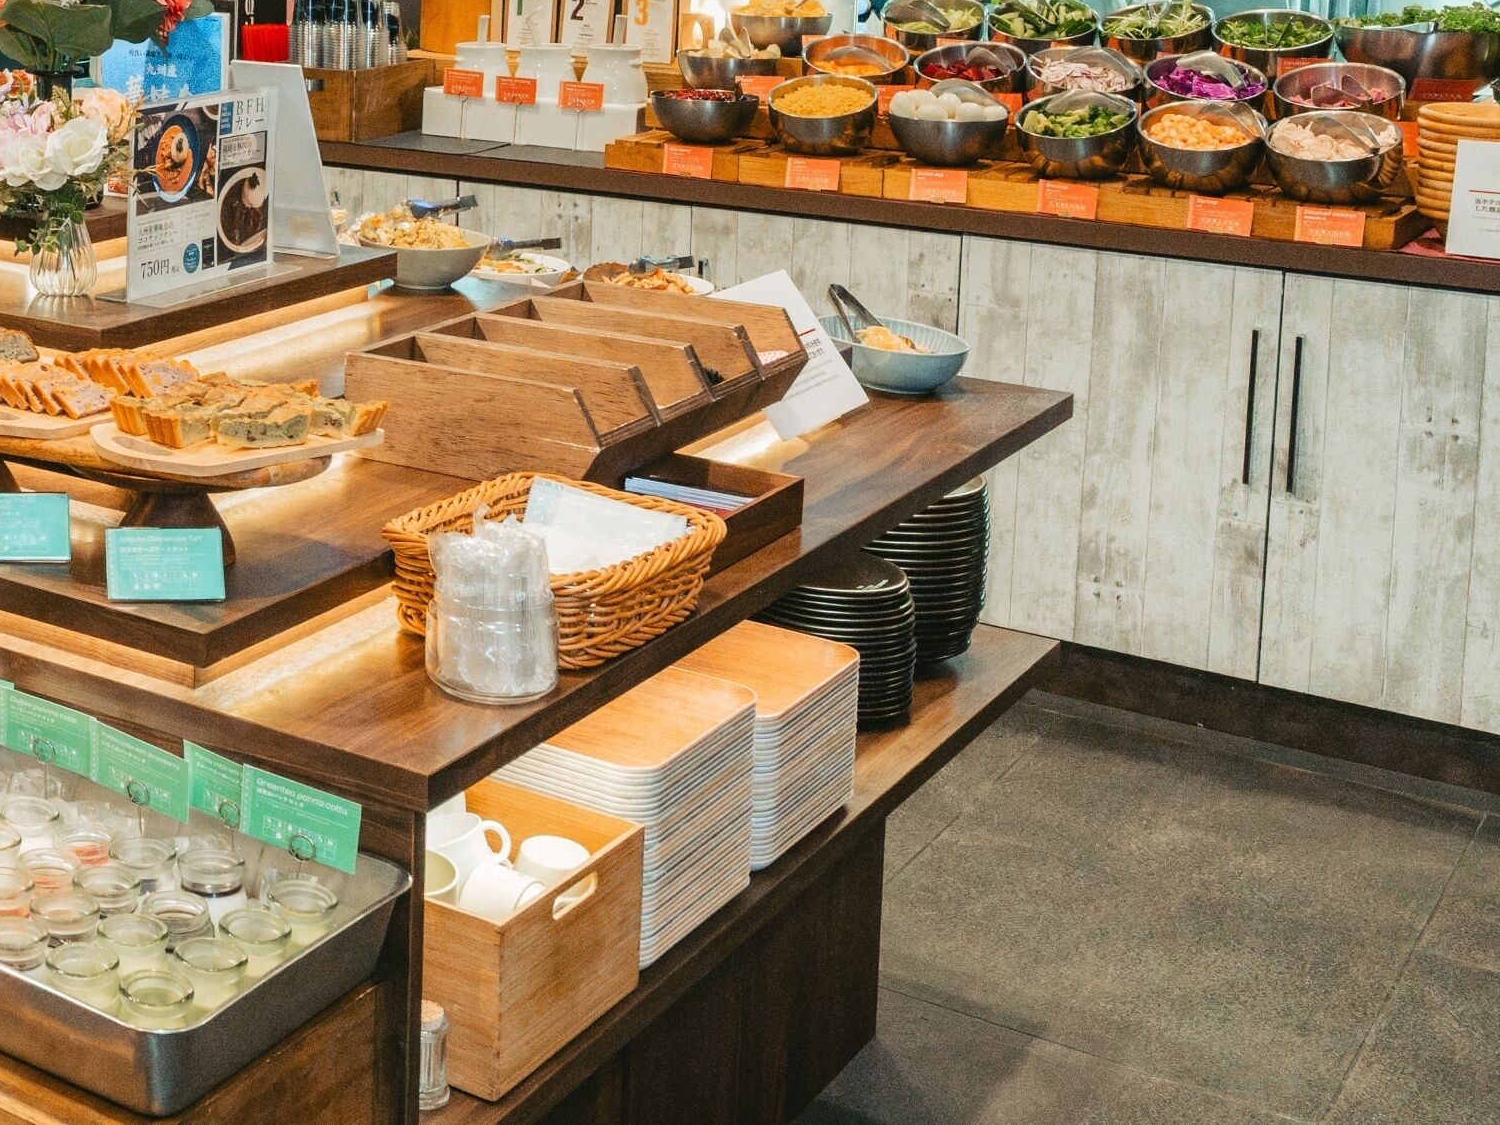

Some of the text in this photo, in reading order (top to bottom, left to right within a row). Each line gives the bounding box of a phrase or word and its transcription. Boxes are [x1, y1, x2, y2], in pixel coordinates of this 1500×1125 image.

[235, 116, 264, 131] カレー
[141, 259, 170, 279] 750円
[296, 792, 325, 807] panna
[325, 802, 348, 816] cotta
